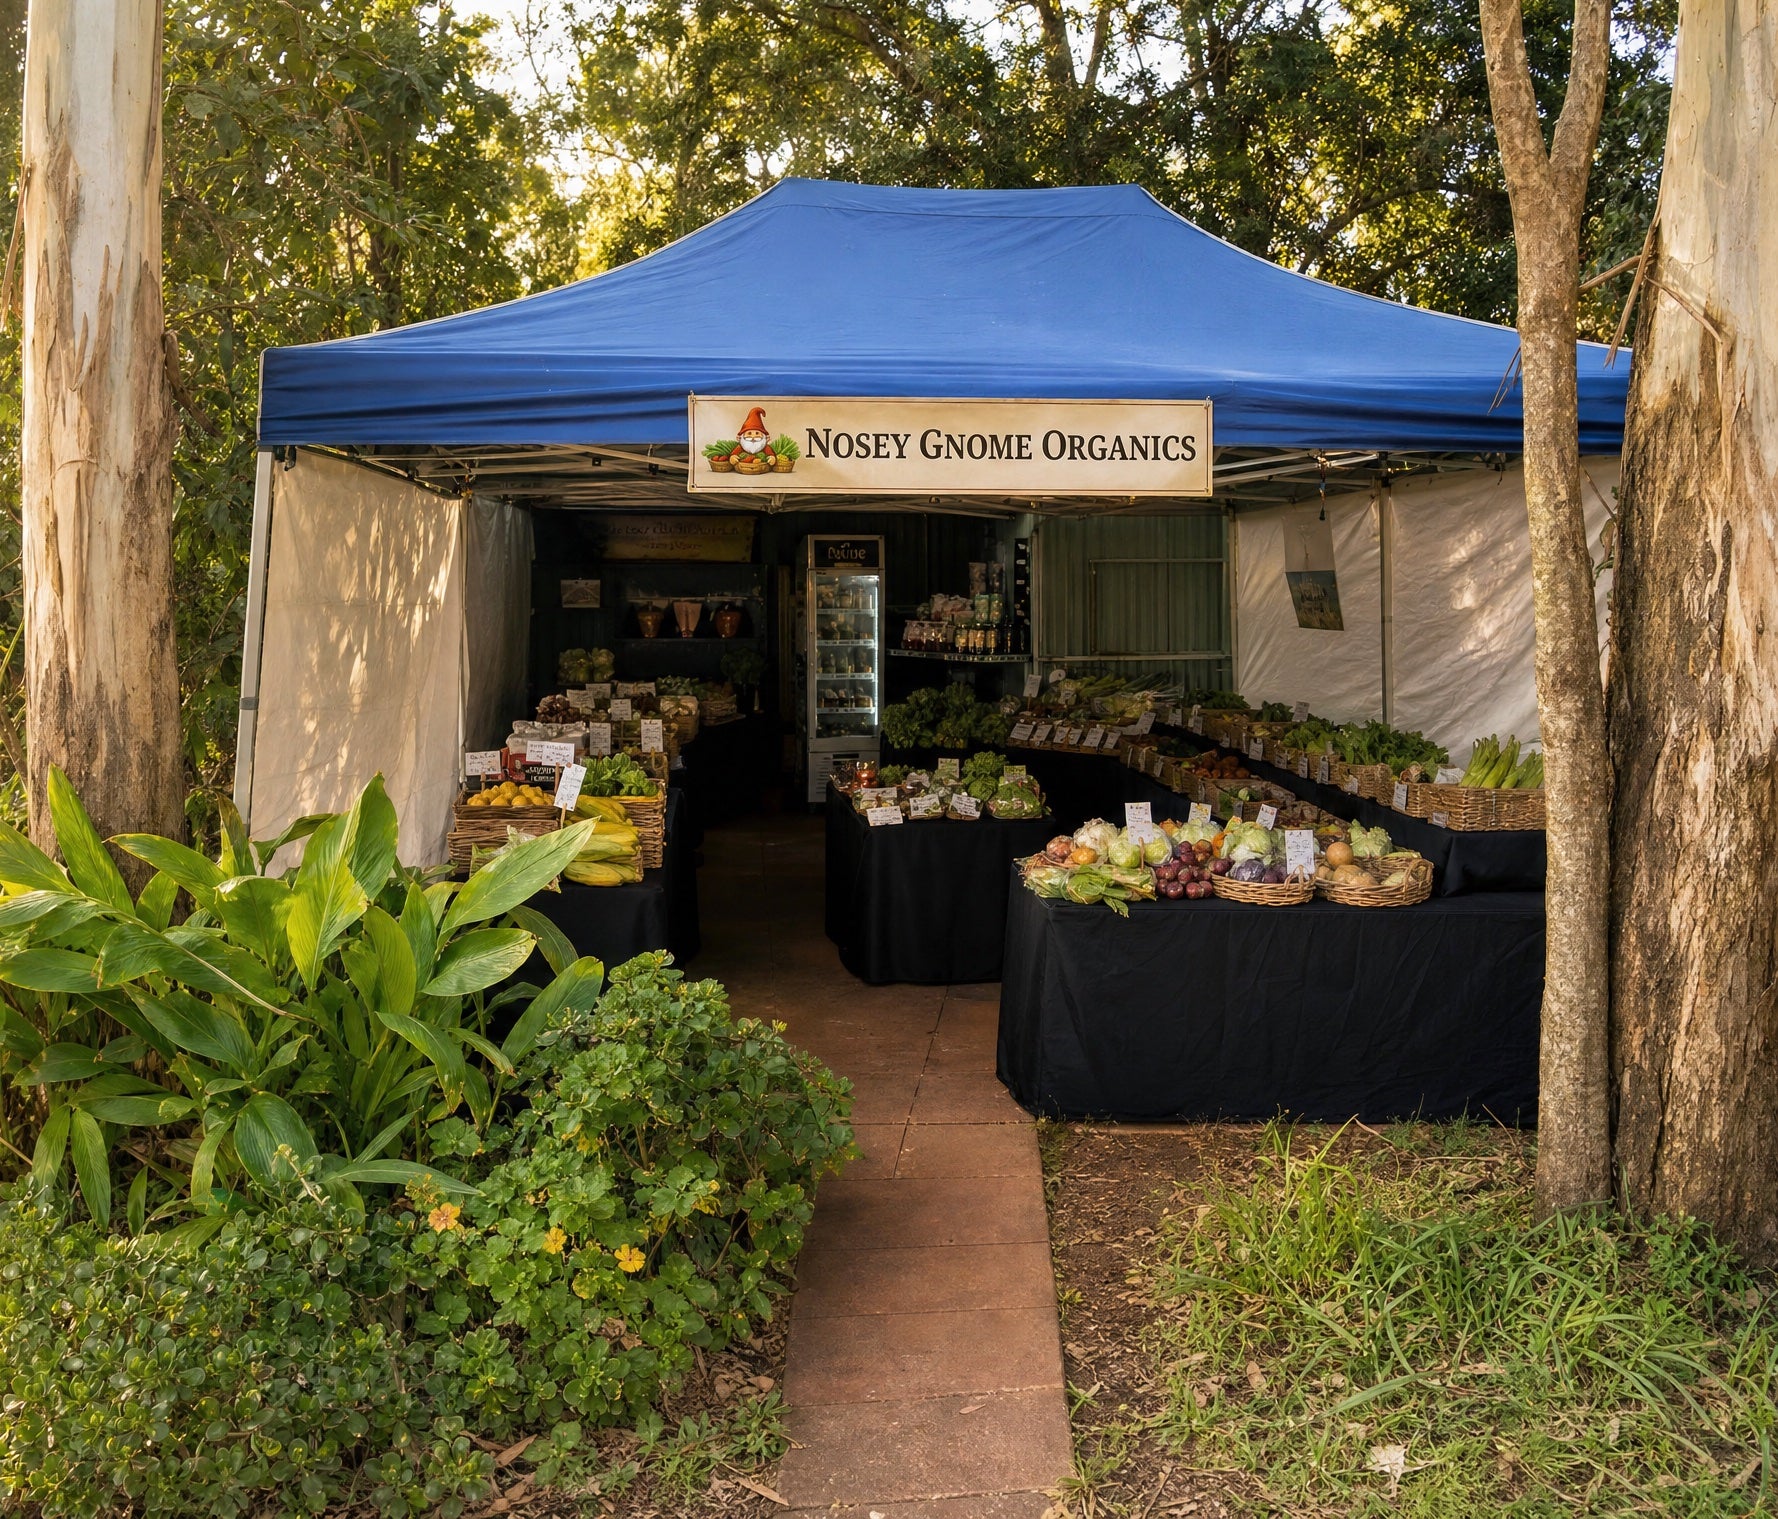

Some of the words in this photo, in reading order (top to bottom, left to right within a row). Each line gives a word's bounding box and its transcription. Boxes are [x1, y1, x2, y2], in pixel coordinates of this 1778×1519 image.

[806, 428, 911, 459] NOSEY
[919, 428, 1032, 460] GNOME
[1042, 429, 1196, 462] ORGANICS
